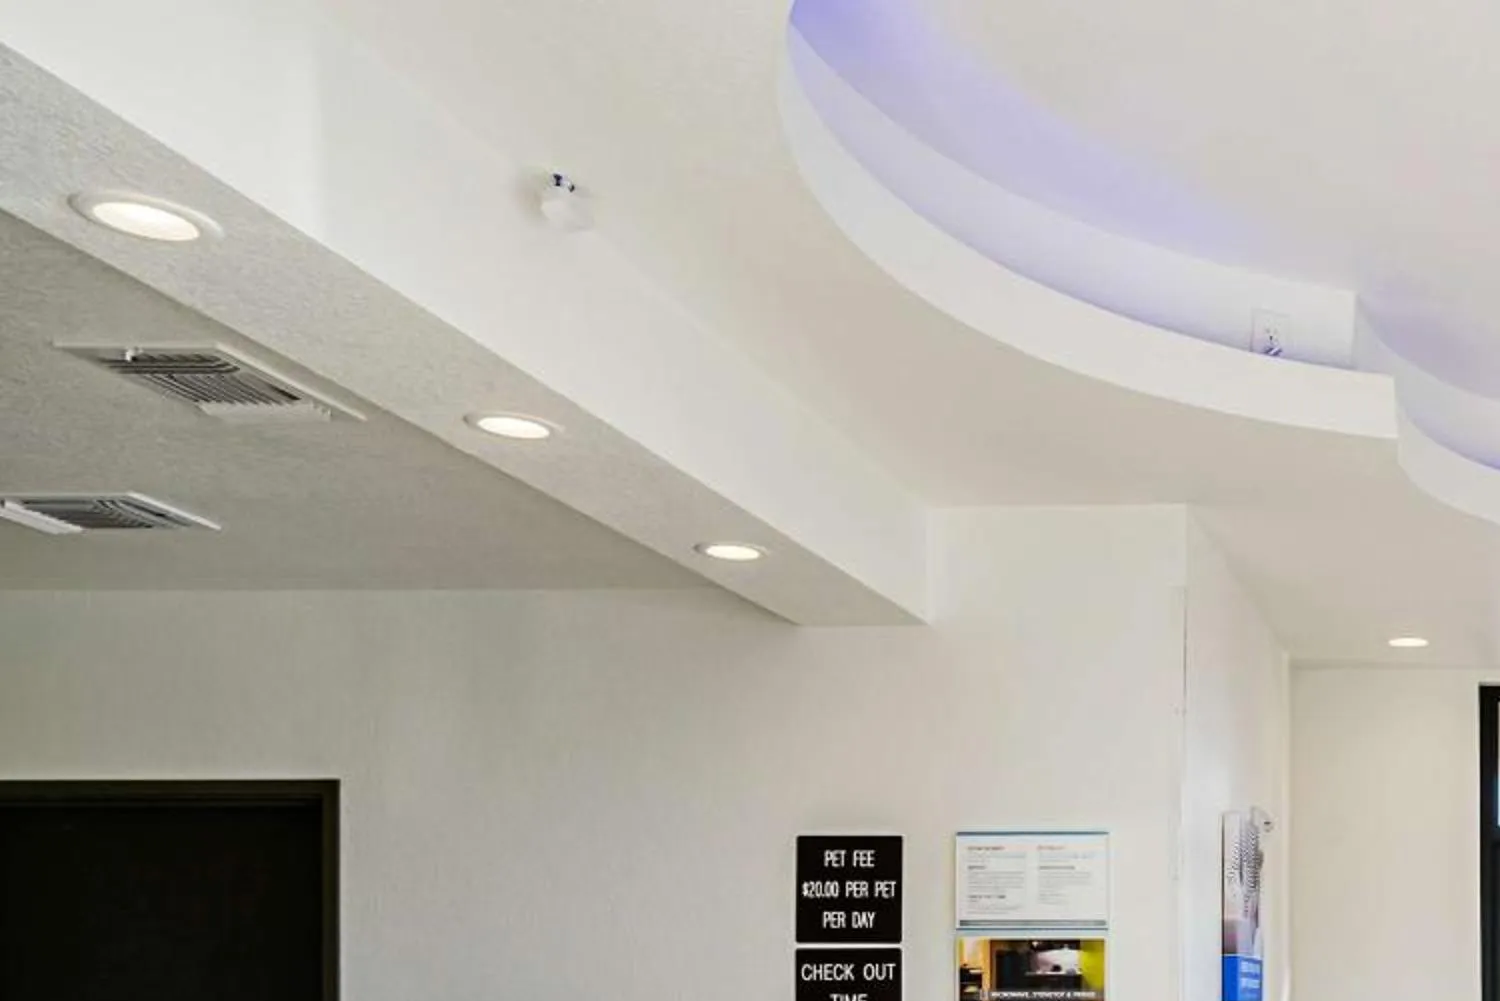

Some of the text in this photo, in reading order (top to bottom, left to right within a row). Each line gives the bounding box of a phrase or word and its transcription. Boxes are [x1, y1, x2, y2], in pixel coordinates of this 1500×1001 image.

[824, 849, 876, 867] PET FEE
[802, 880, 896, 898] $20.00 PER PET
[823, 911, 876, 929] PER DAY
[801, 963, 896, 981] CHECK OUT
